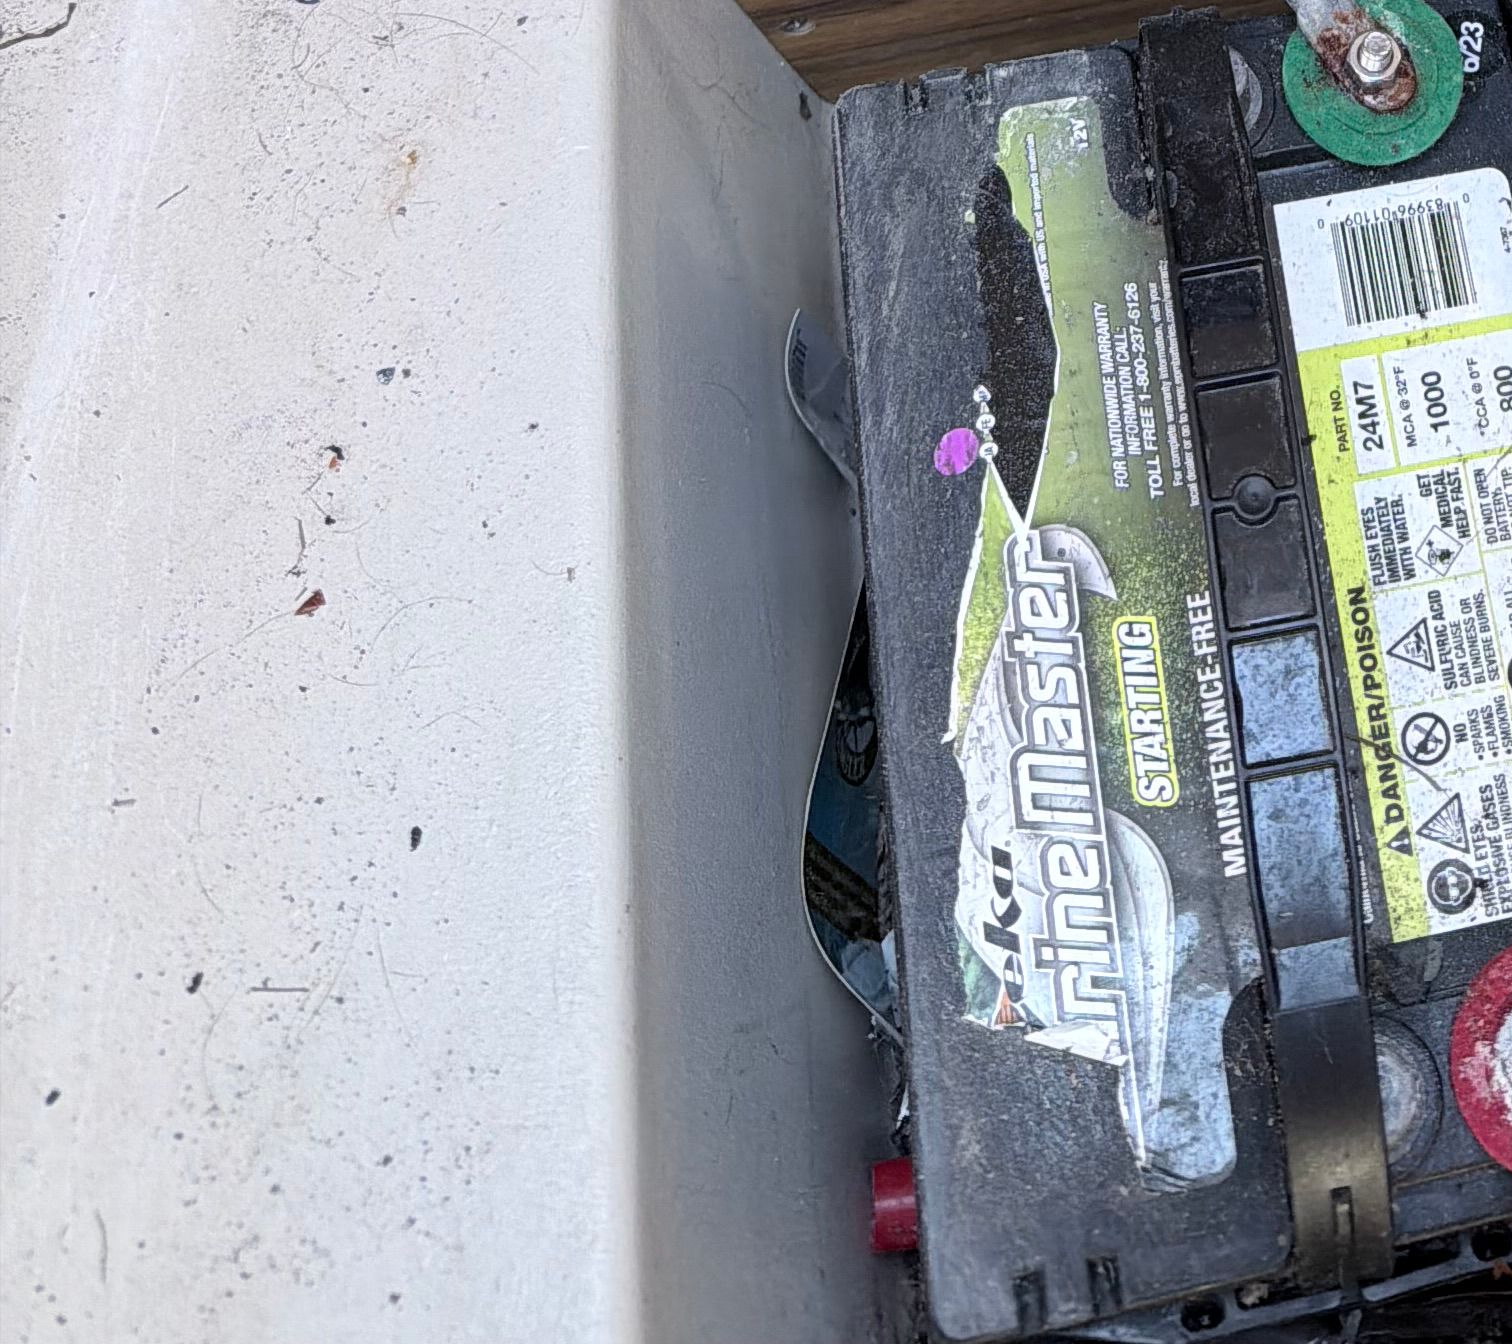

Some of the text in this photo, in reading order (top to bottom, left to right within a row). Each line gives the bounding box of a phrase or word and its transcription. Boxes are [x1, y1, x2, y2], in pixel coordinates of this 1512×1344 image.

[1071, 116, 1089, 149] 12V
[1316, 192, 1470, 229] 0 83996 01109 0
[1092, 300, 1129, 488] FOR NATIONWIDE WARRANTY
[1123, 281, 1164, 498] TOLL FREE 1-800-237-6126
[1392, 364, 1417, 447] MCA @ 32°F
[1419, 369, 1450, 433] 1000
[1466, 356, 1480, 379] 0°F
[1470, 381, 1483, 394] @
[1118, 365, 1142, 456] INFORMATION
[1328, 384, 1350, 452] PART NO.
[1351, 377, 1384, 453] 24M7
[1416, 472, 1432, 497] GET
[1431, 468, 1453, 528] MEDICAL
[1446, 466, 1471, 538] HELP FAST.
[1473, 467, 1498, 544] DO NOT OPEN
[1360, 506, 1386, 586] FLUSH EYES
[1374, 494, 1401, 583] IMMEDIATELY
[1389, 493, 1416, 580] WITH WATER.
[1427, 589, 1457, 690] SULFURIC ACID
[1449, 619, 1471, 687] CAN CAUSE
[1460, 597, 1485, 683] BLINDNESS OR
[1472, 588, 1500, 681] SEVERE BURNS.
[1120, 622, 1175, 803] STARTING
[1187, 590, 1247, 878] MAINTENANCE-FREE
[1346, 584, 1404, 825] DANGER/POISON
[1452, 722, 1468, 743] NO
[1011, 534, 1118, 1017] rine Master
[1478, 783, 1500, 831] GASES
[983, 845, 1026, 1024] eka
